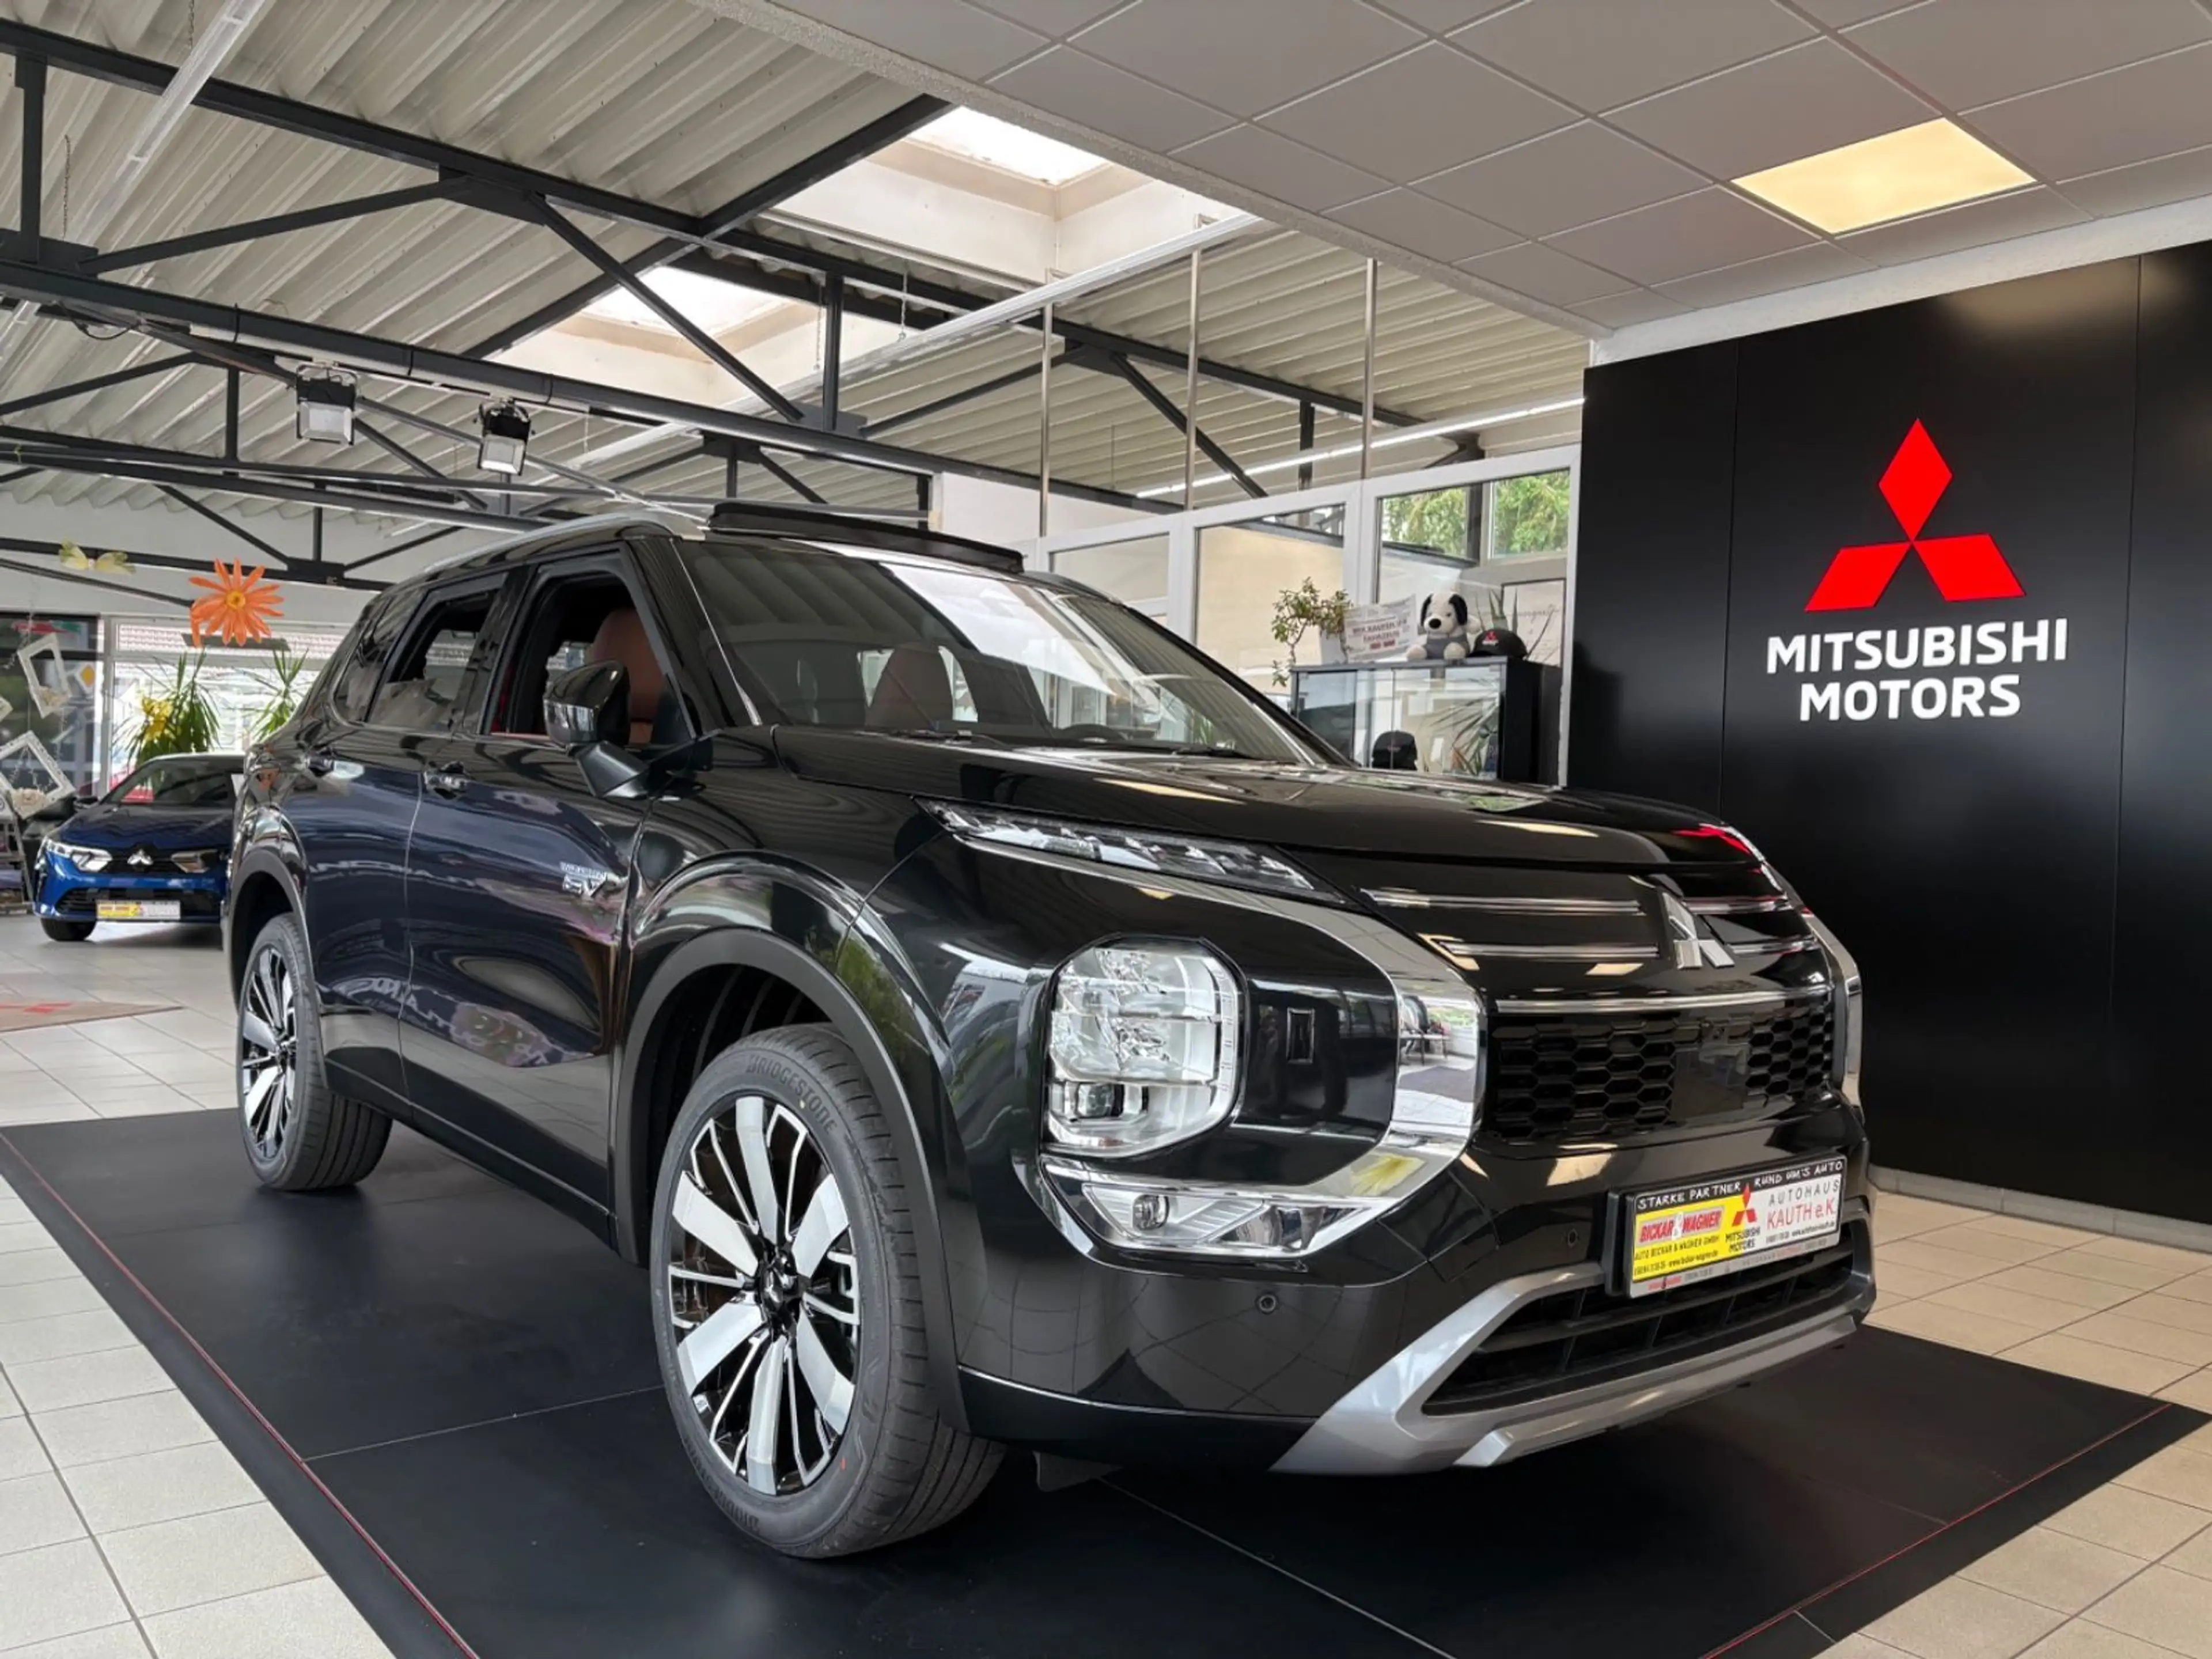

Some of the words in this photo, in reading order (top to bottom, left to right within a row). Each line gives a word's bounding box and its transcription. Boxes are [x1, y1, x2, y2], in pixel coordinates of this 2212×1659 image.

[1767, 618, 2067, 674] MITSUBISHI
[1800, 674, 2021, 722] MOTORS
[746, 1054, 837, 1134] BRIDGESTONE
[1637, 1192, 1685, 1210] STARKE
[1690, 1181, 1741, 1200] PARTNER
[1754, 1174, 1782, 1187] RUND
[1814, 1161, 1843, 1176] AUTO
[1768, 1180, 1840, 1207] AUTOHAUS
[1766, 1202, 1812, 1231] KAUTH
